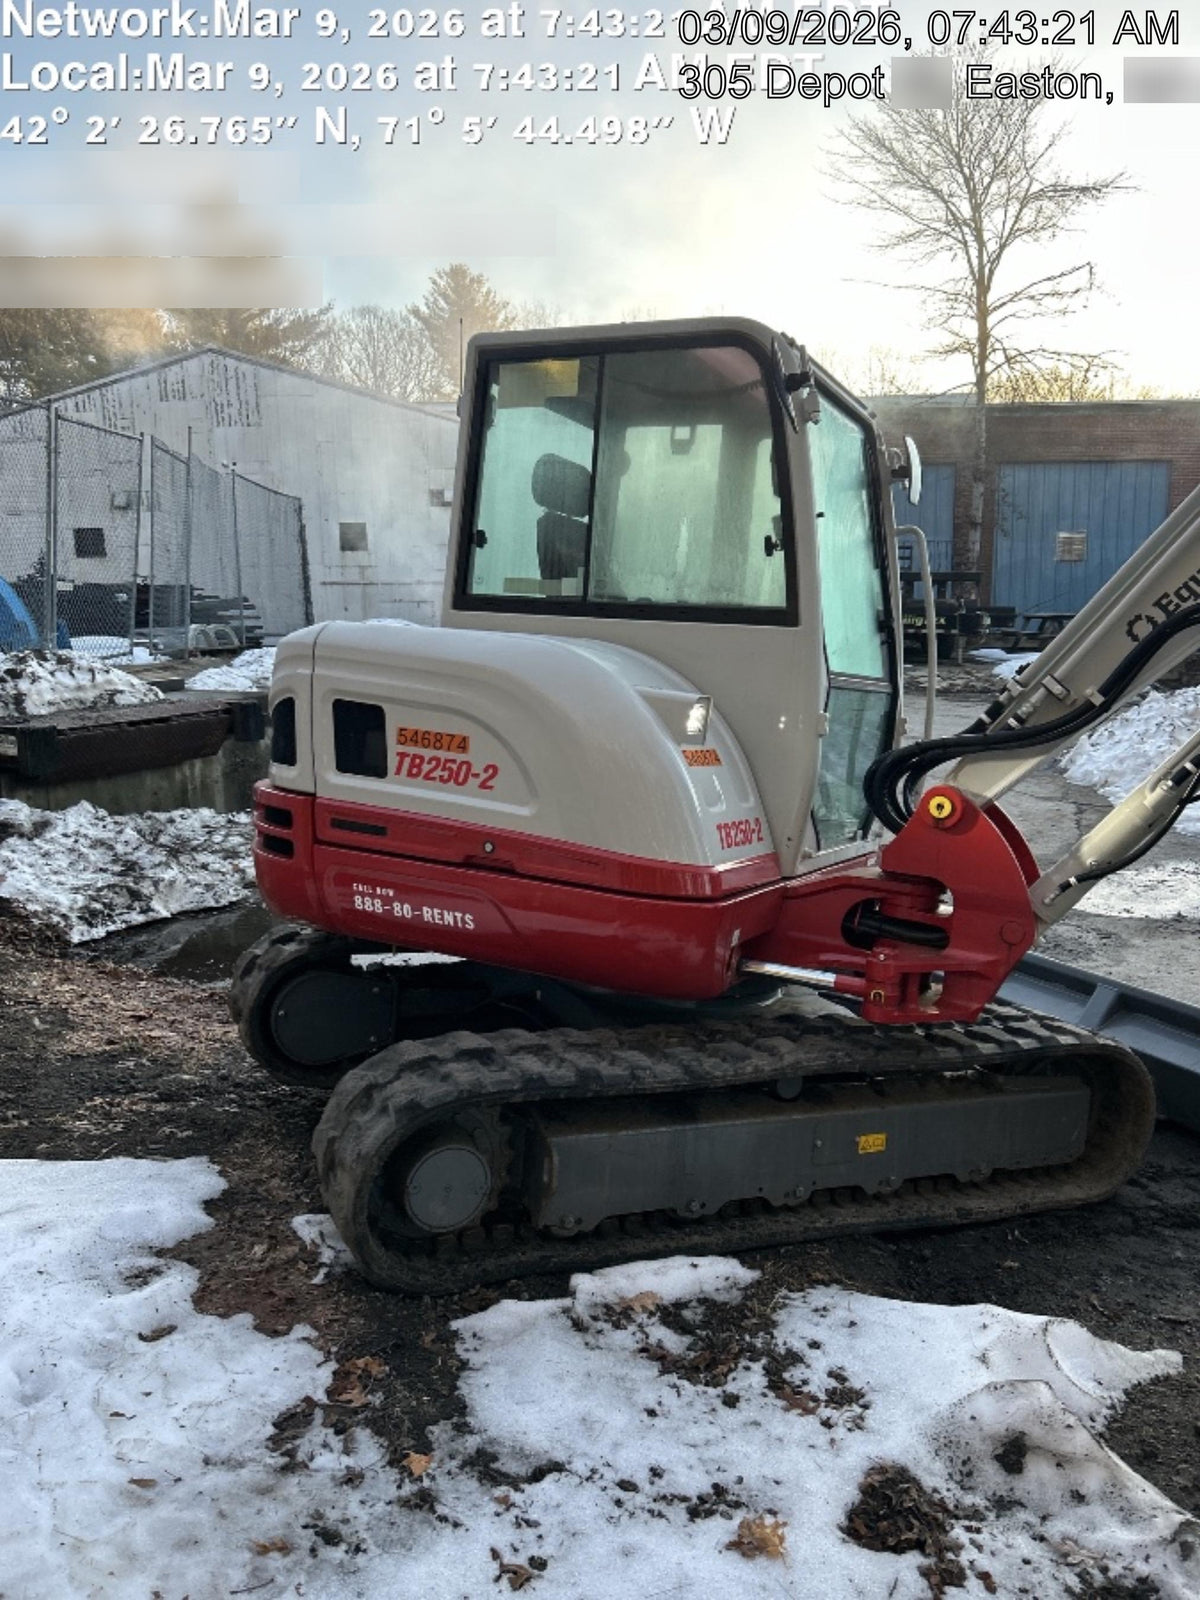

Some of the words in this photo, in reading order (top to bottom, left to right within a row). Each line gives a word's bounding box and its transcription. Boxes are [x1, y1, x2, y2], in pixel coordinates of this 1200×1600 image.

[398, 728, 469, 753] 546874
[394, 752, 499, 790] TB250-2
[716, 817, 763, 850] TB250-2
[354, 895, 475, 930] 888-80-RENTS
